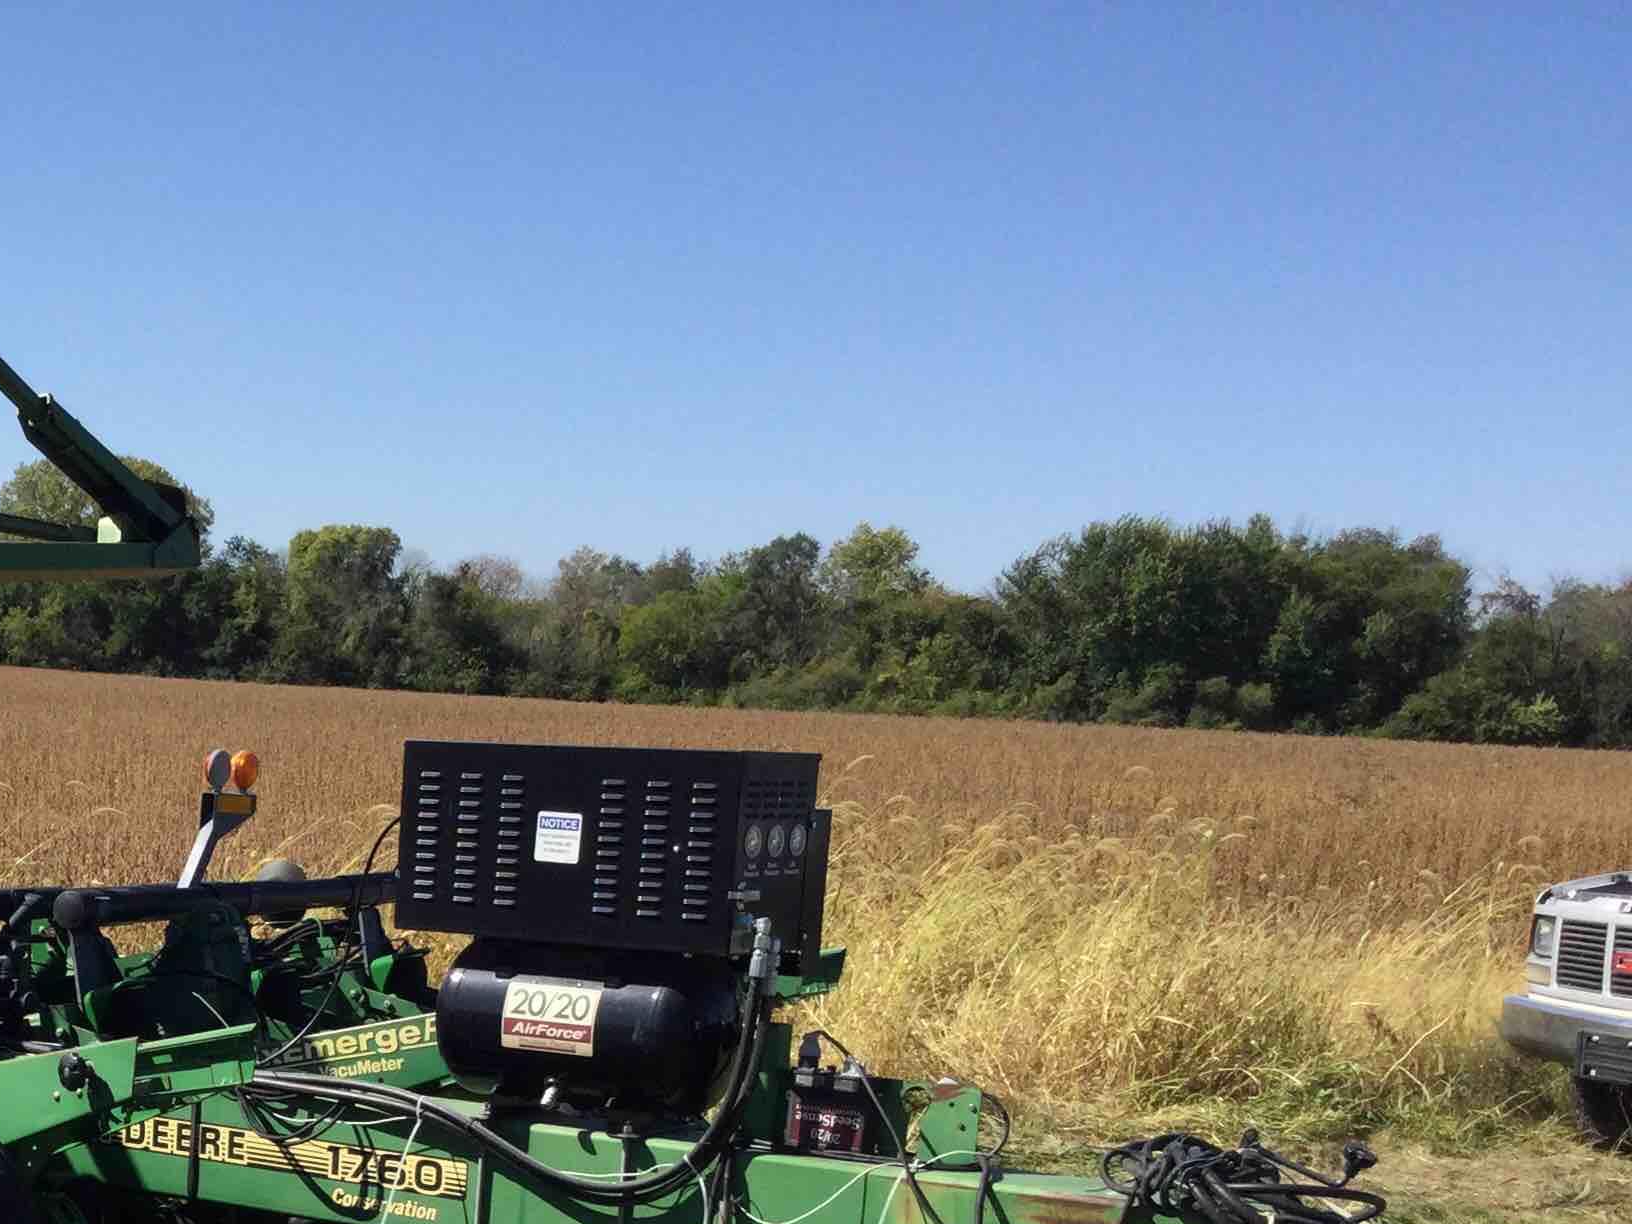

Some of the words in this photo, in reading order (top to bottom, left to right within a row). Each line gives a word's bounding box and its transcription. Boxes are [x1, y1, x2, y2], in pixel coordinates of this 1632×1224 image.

[540, 817, 578, 830] NOTICE
[510, 988, 590, 1021] 20/20
[320, 1056, 405, 1079] VacuMeter
[124, 1118, 246, 1164] DEERE
[331, 1187, 437, 1222] Conservation
